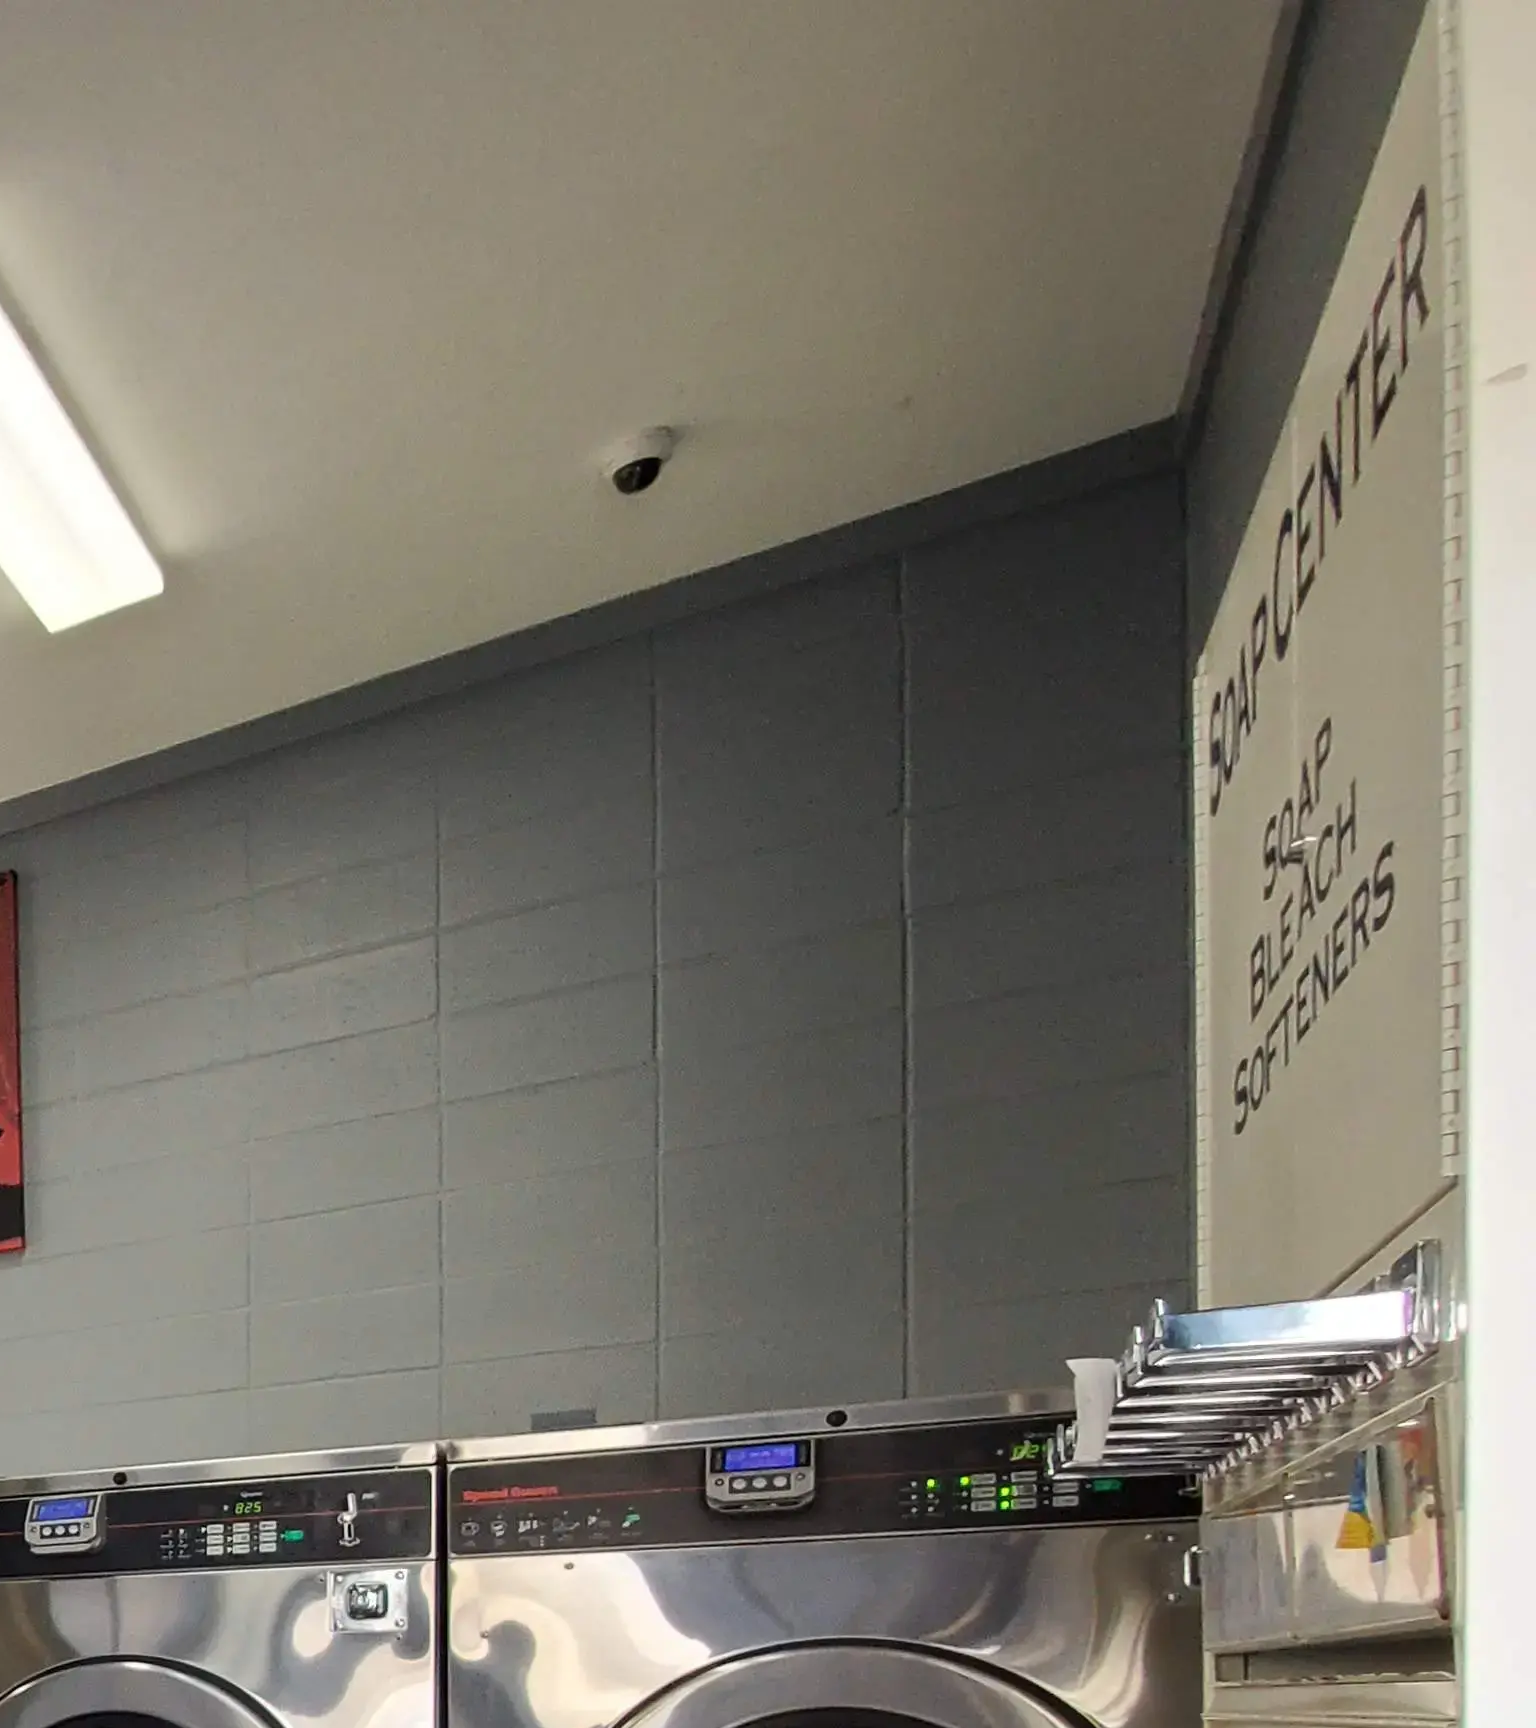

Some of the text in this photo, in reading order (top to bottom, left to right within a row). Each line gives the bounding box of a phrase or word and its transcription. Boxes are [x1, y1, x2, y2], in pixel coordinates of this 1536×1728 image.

[1249, 776, 1358, 1024] BLEACH
[1262, 716, 1333, 901] SOAP
[1232, 839, 1397, 1136] SOFTENERS
[235, 1501, 263, 1515] 825
